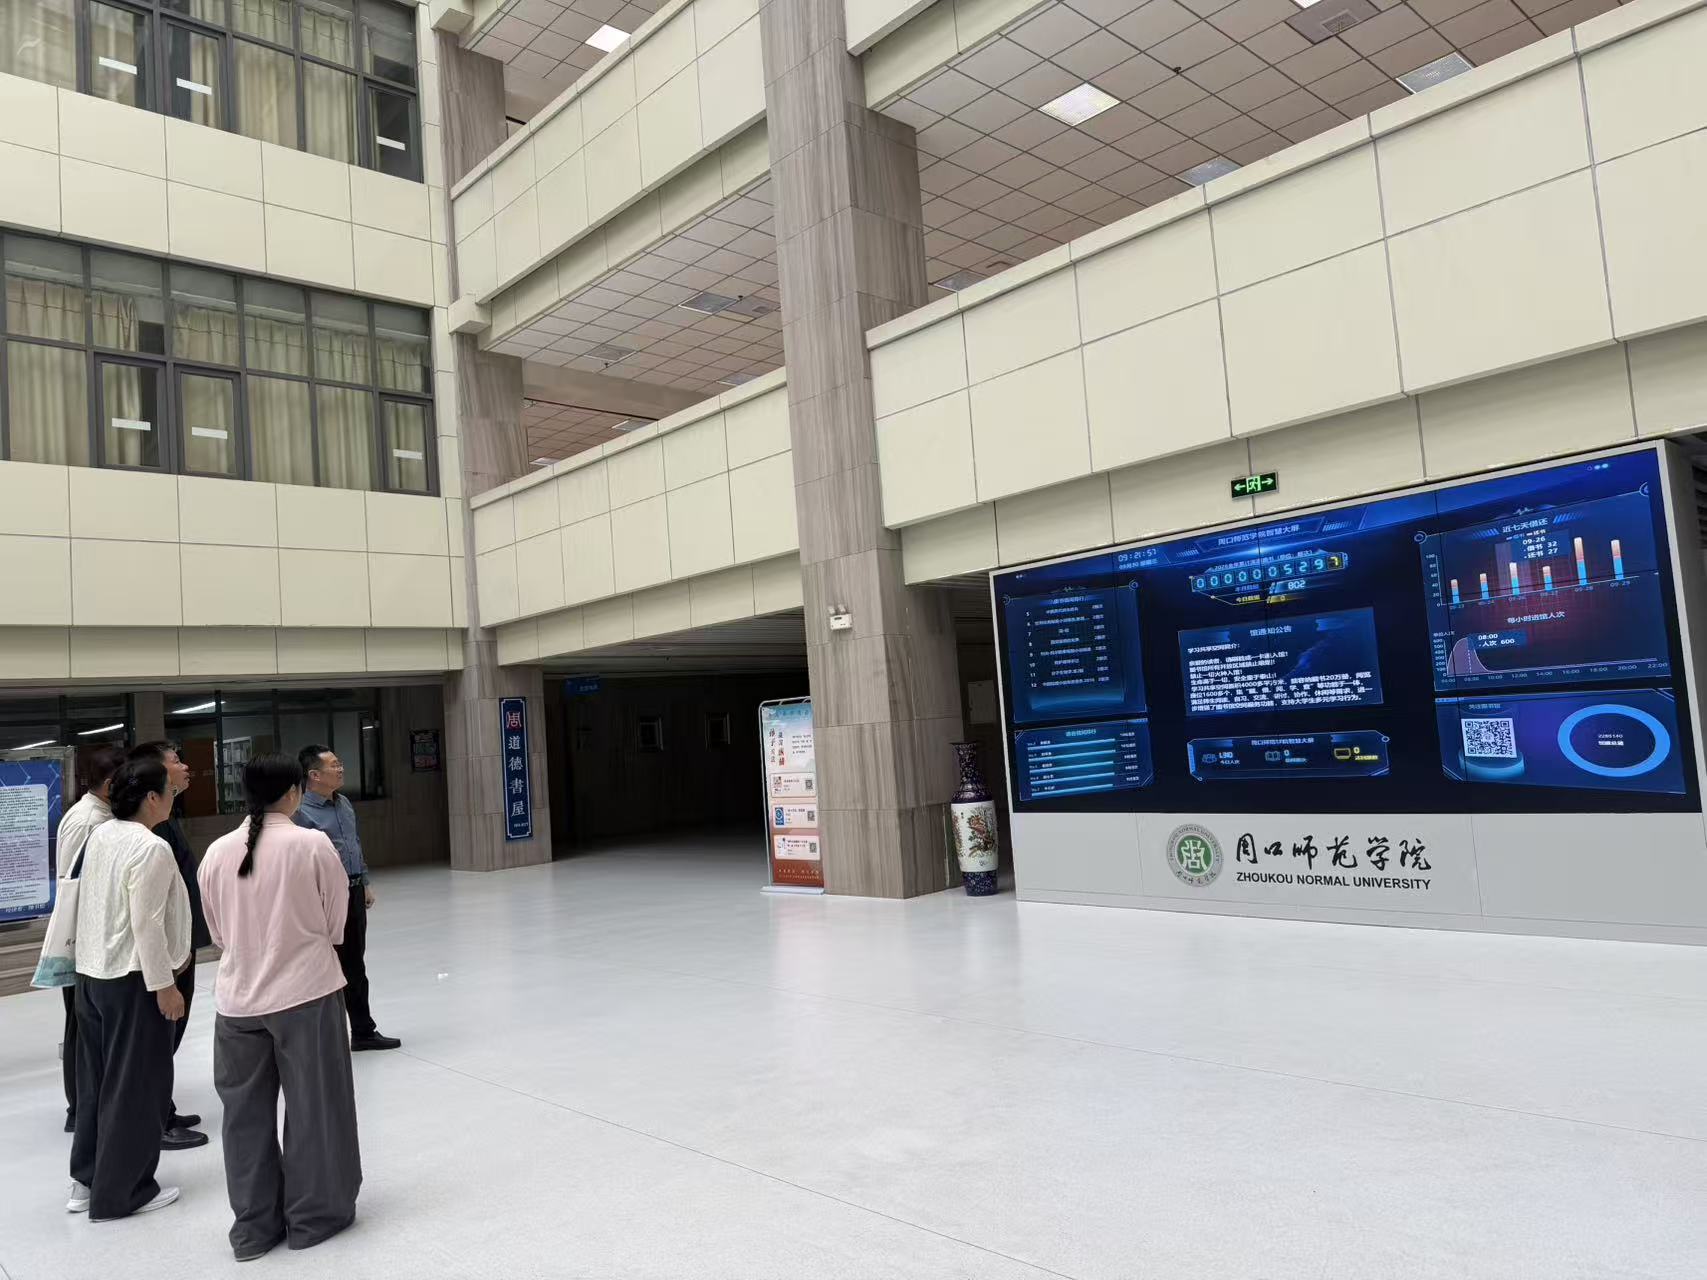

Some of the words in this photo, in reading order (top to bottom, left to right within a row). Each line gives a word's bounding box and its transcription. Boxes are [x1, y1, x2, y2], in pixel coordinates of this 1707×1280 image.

[1503, 518, 1548, 533] 近七天借还
[1507, 611, 1565, 624] 每小时进馆人次
[1236, 833, 1432, 871] 周口师范学院
[1236, 872, 1293, 885] ZHOUKOU
[1297, 874, 1350, 887] NORMAL
[1353, 876, 1431, 890] UNIVERSITY
